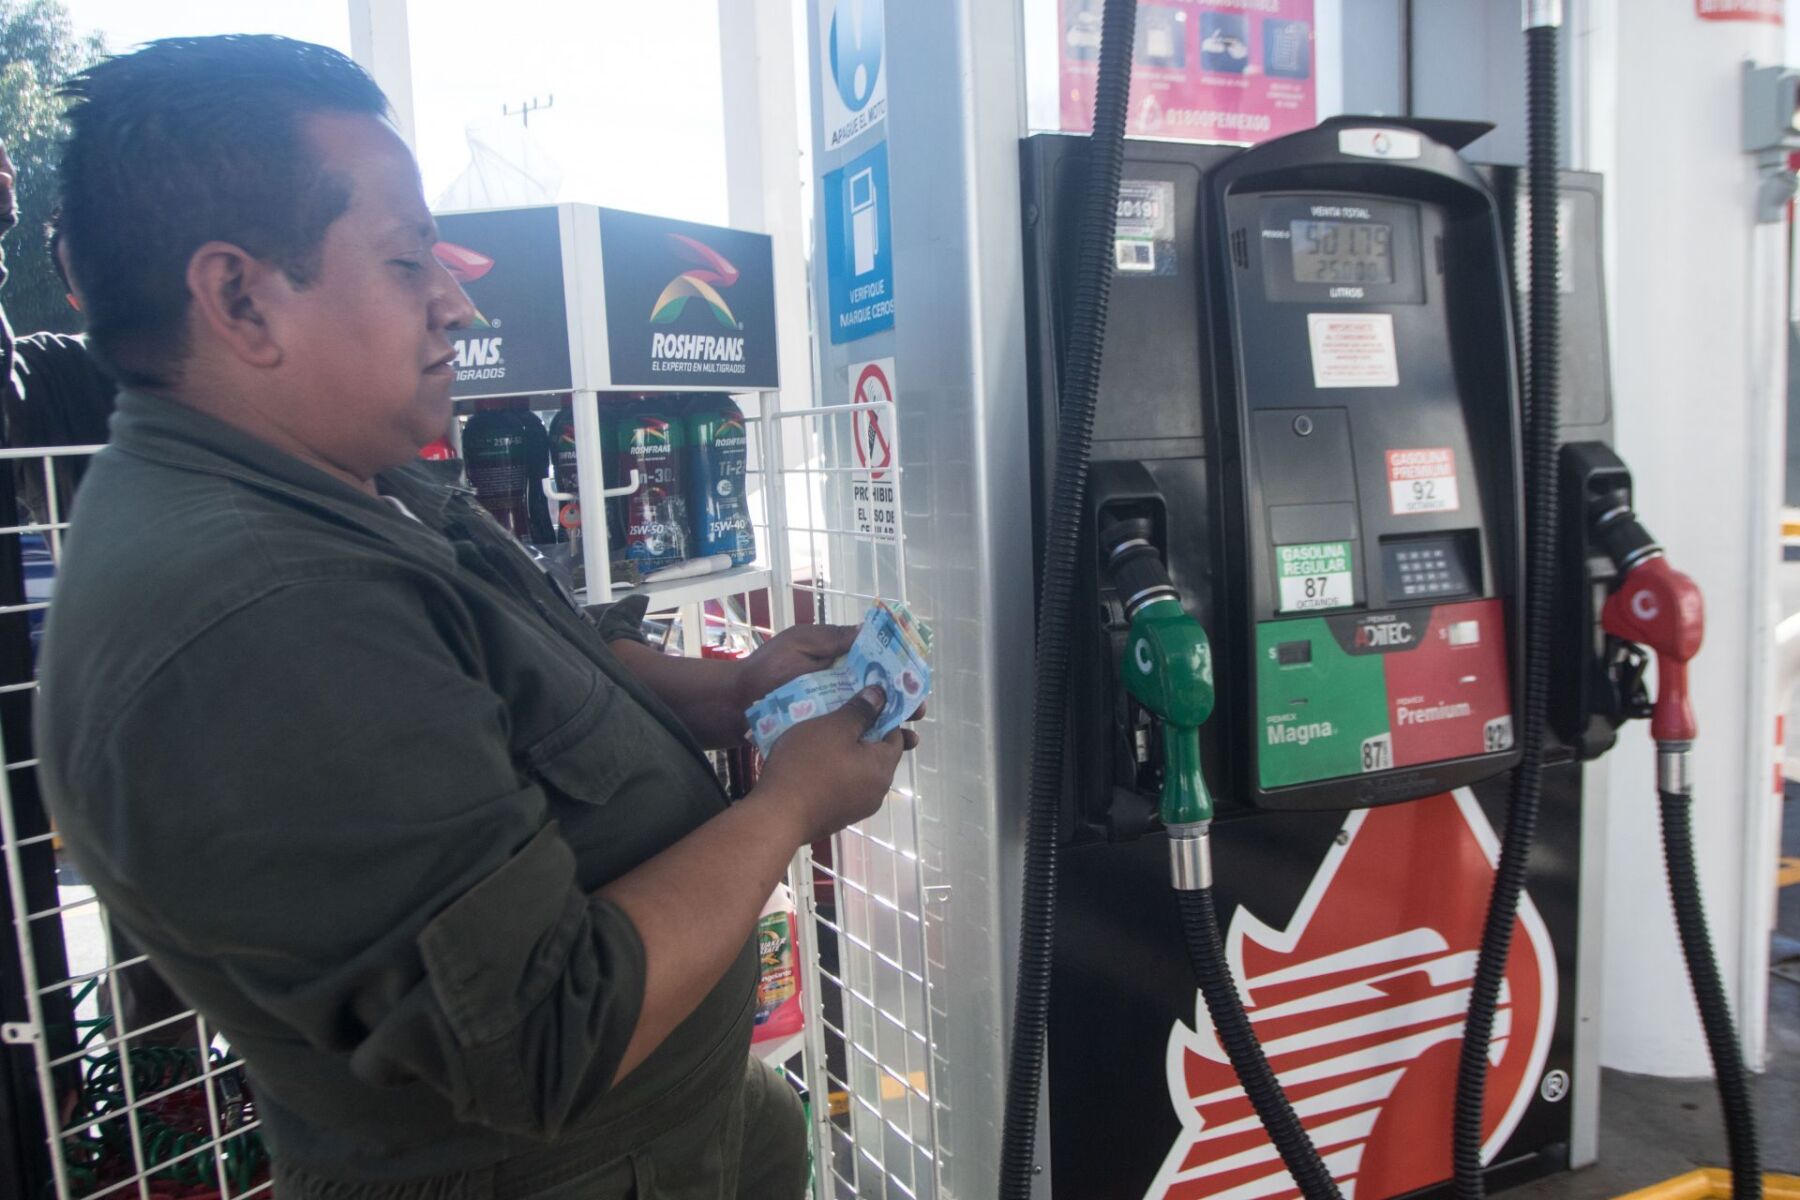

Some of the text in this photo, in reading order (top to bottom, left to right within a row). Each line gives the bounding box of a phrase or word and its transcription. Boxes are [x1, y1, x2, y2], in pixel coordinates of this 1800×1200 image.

[831, 117, 859, 146] APAGUE
[849, 279, 885, 304] VERIFIQUE
[1329, 287, 1364, 299] LITROS
[840, 299, 895, 328] MARQUE CEROS
[651, 332, 744, 362] ROSHFRANS
[652, 361, 746, 374] EL EXPERTO EN MULTIGRADOS
[631, 444, 671, 455] ROSHFRANS
[1412, 480, 1436, 500] 92
[858, 508, 895, 524] EL SO DE
[1282, 543, 1346, 561] GASOLINA
[1283, 557, 1346, 577] REGULAR
[1305, 576, 1328, 599] 87
[1397, 700, 1471, 726] Premium
[1267, 721, 1333, 746] Magna
[1362, 742, 1384, 770] 87
